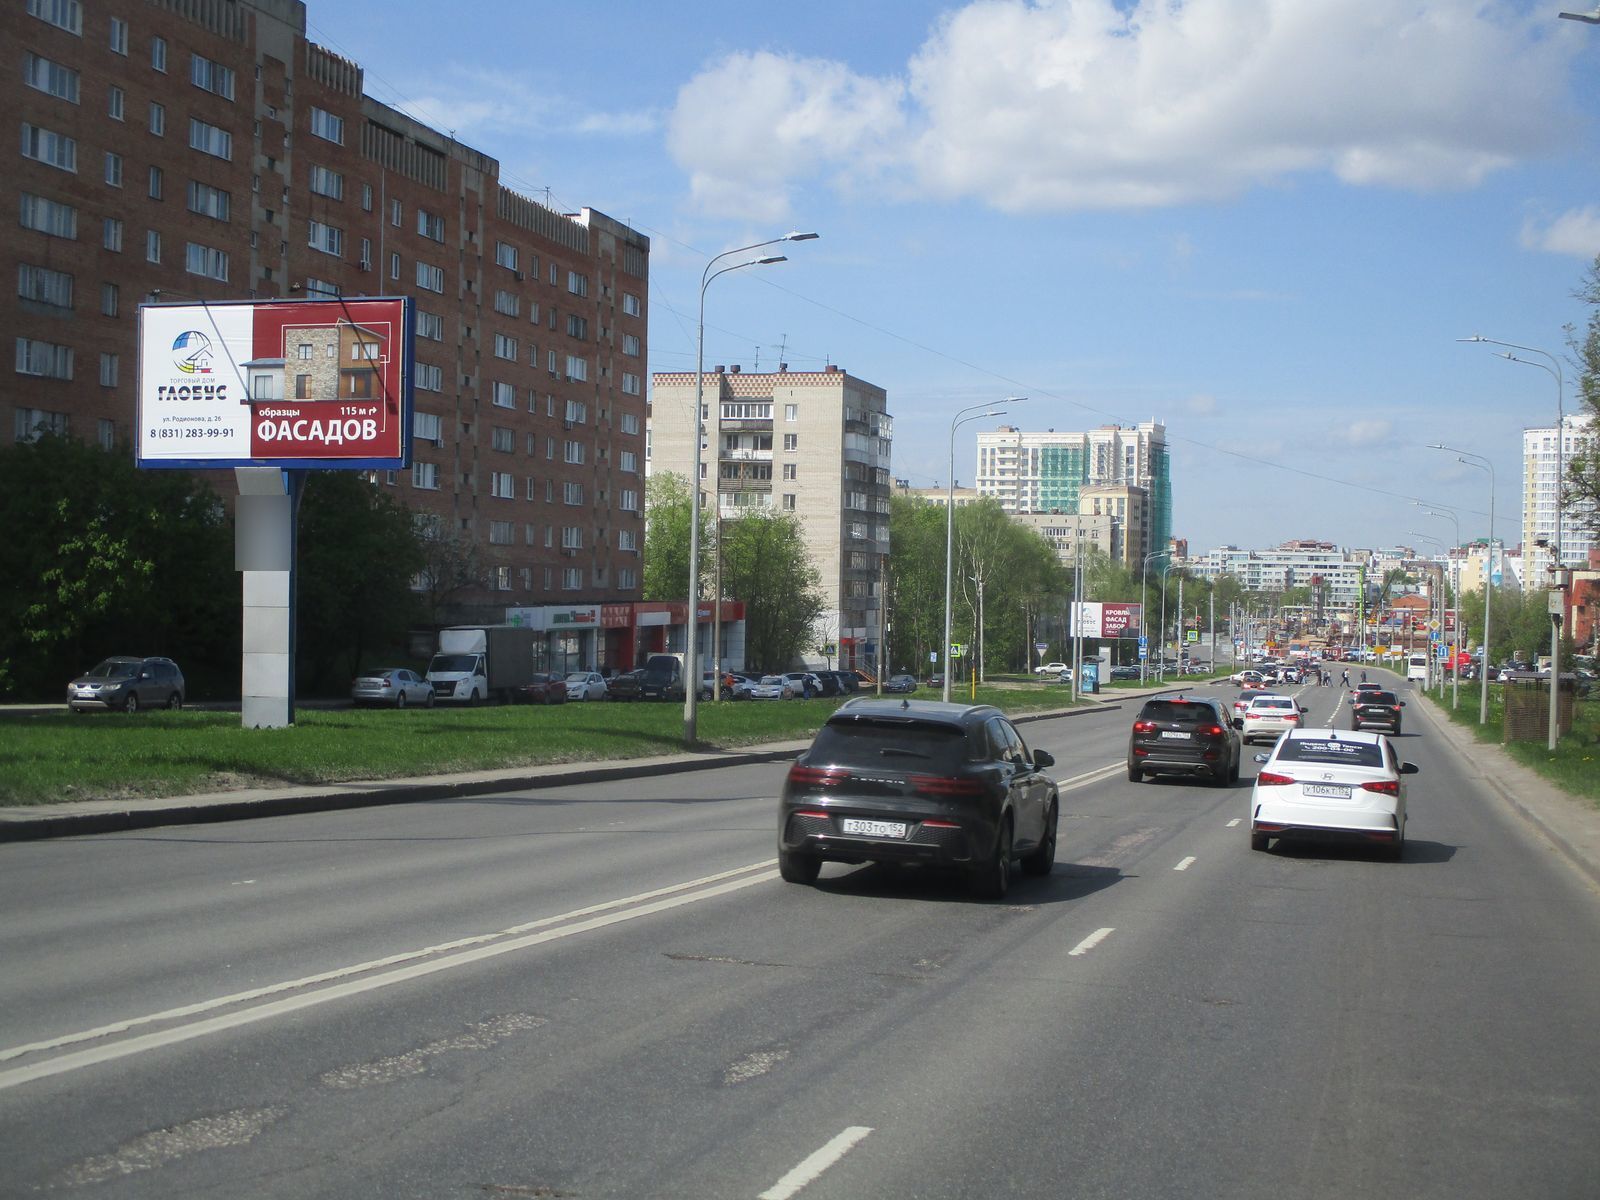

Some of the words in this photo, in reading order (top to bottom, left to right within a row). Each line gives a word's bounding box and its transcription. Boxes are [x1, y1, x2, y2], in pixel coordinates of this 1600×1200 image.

[158, 385, 227, 401] ГЛОБУС
[259, 407, 300, 418] образцы
[340, 406, 357, 415] 115
[150, 429, 156, 438] 8
[159, 428, 183, 439] (831)
[185, 428, 234, 438] 283-99-91
[257, 419, 377, 445] ФАСАДОВ
